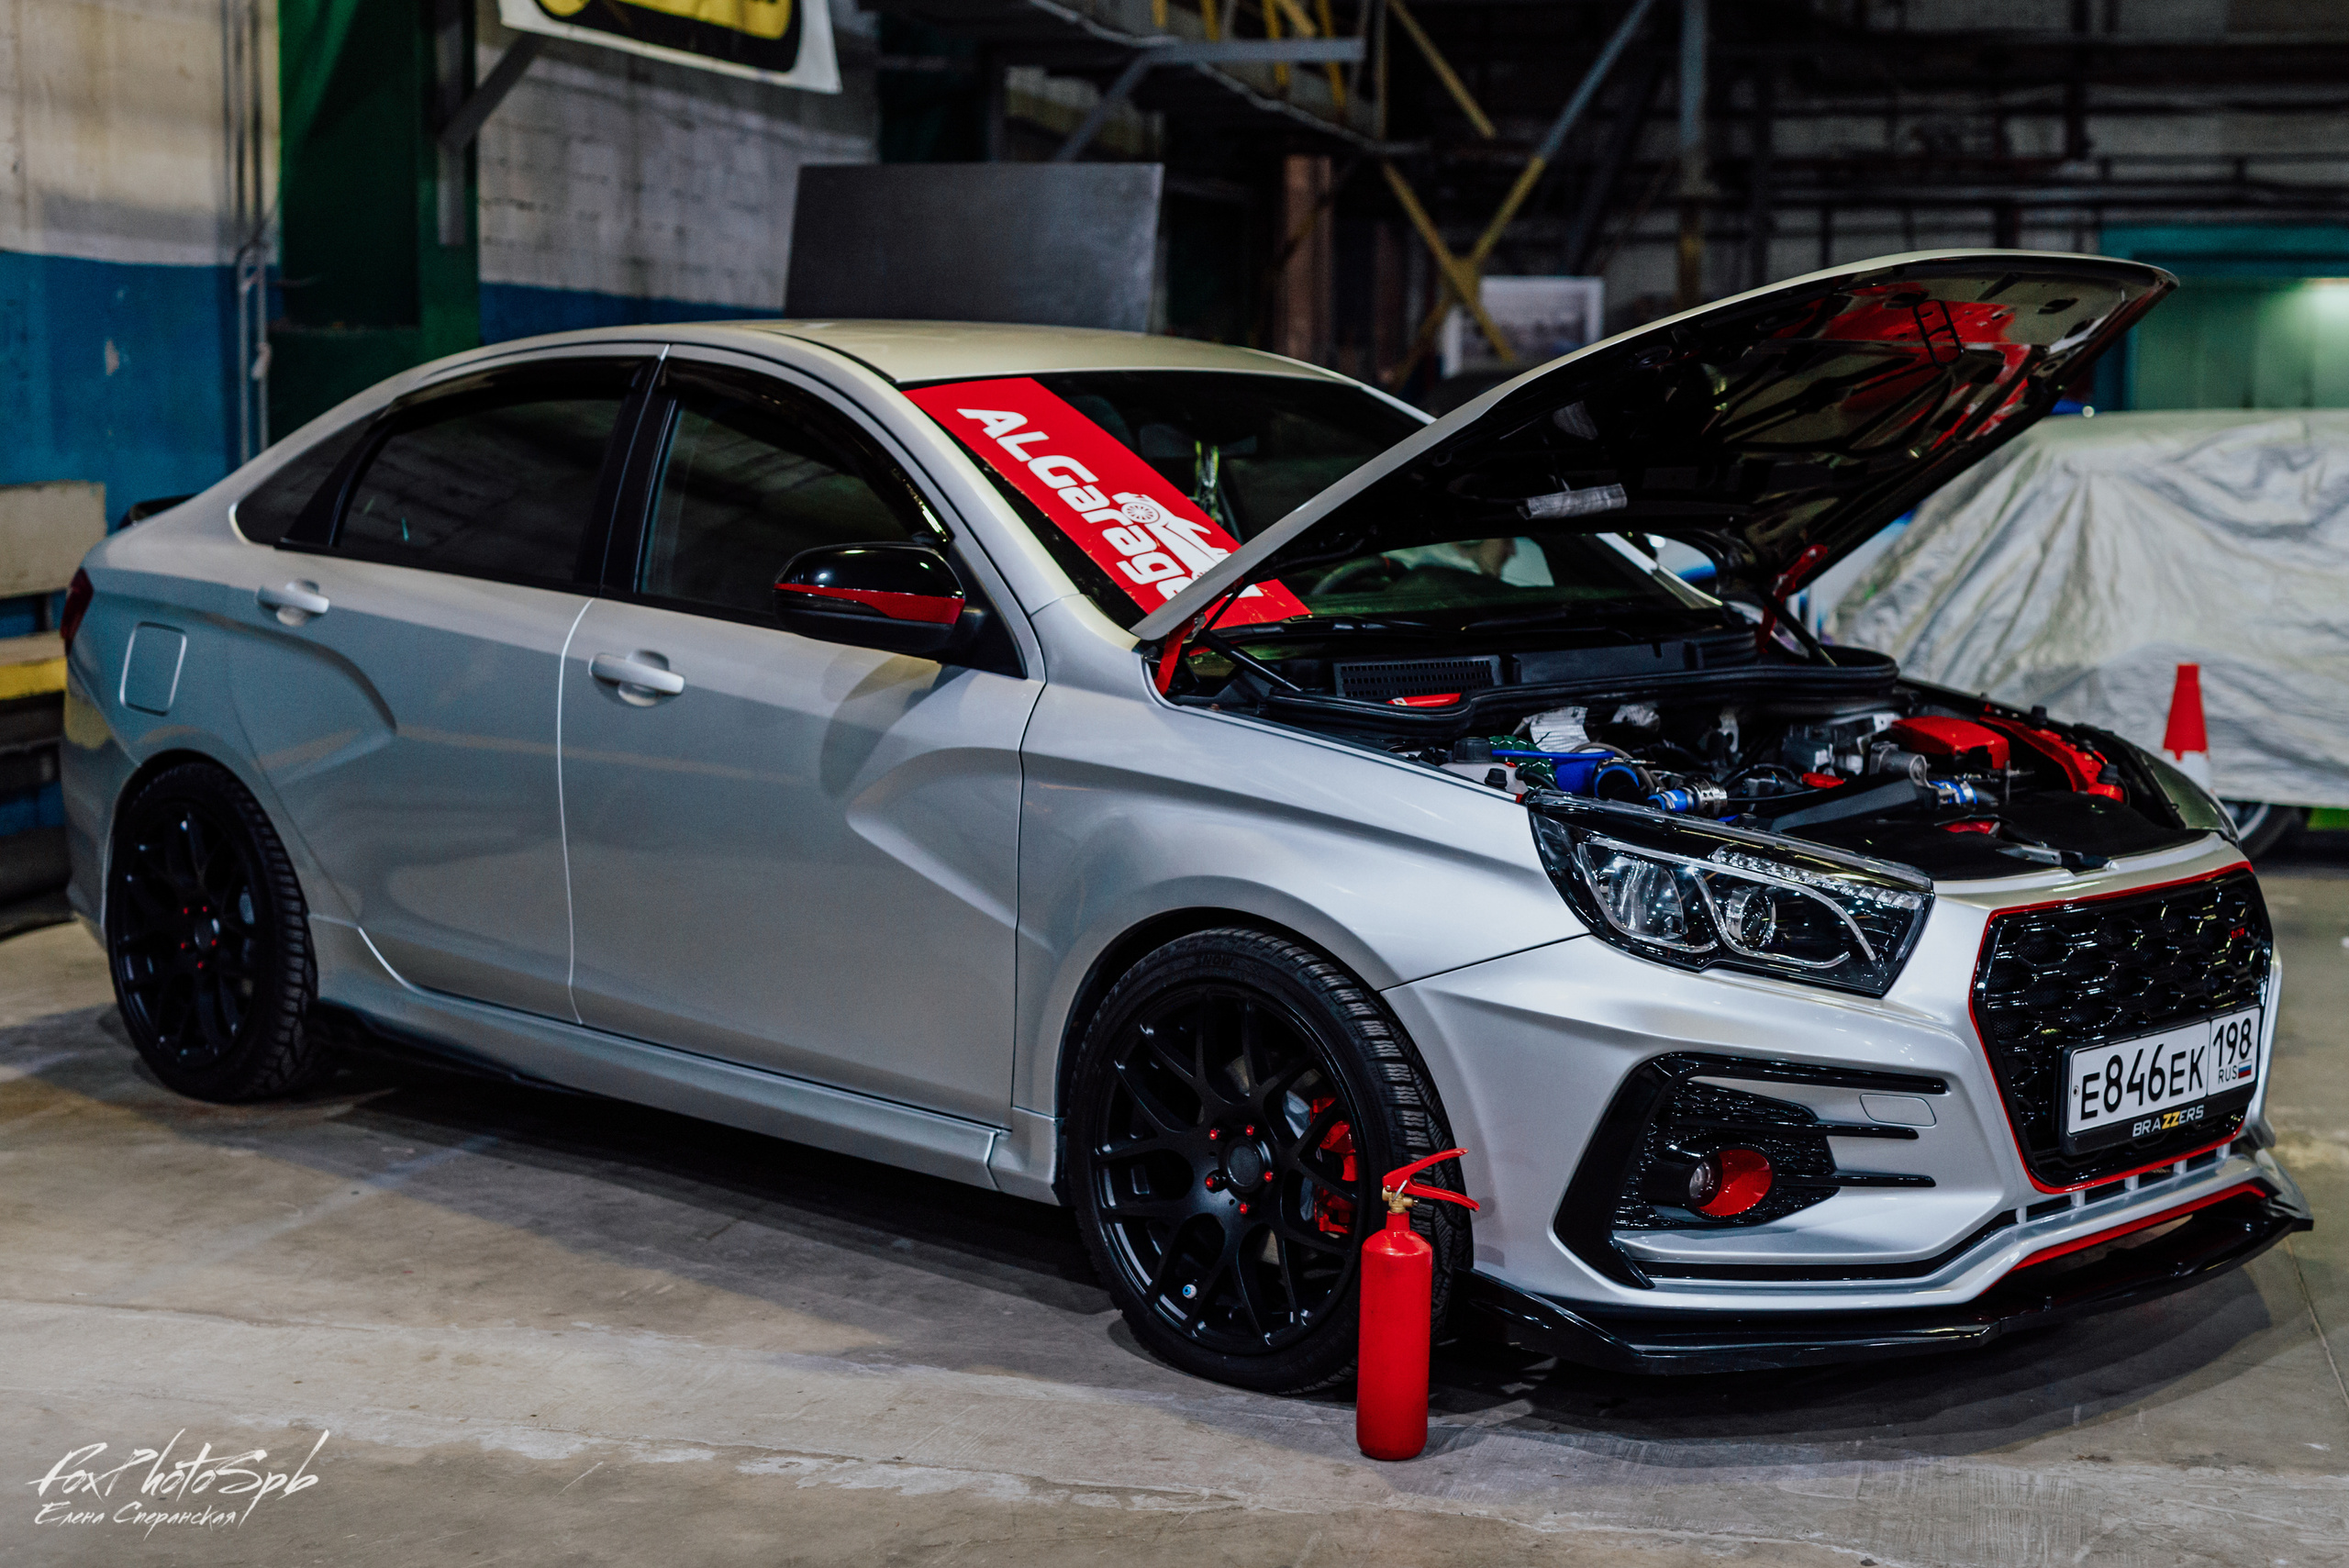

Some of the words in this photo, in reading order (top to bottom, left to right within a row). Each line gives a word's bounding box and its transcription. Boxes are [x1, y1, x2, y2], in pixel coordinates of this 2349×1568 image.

[2212, 1017, 2253, 1068] 198
[2218, 1065, 2238, 1084] RUS
[2132, 1104, 2204, 1137] BRAZZERS
